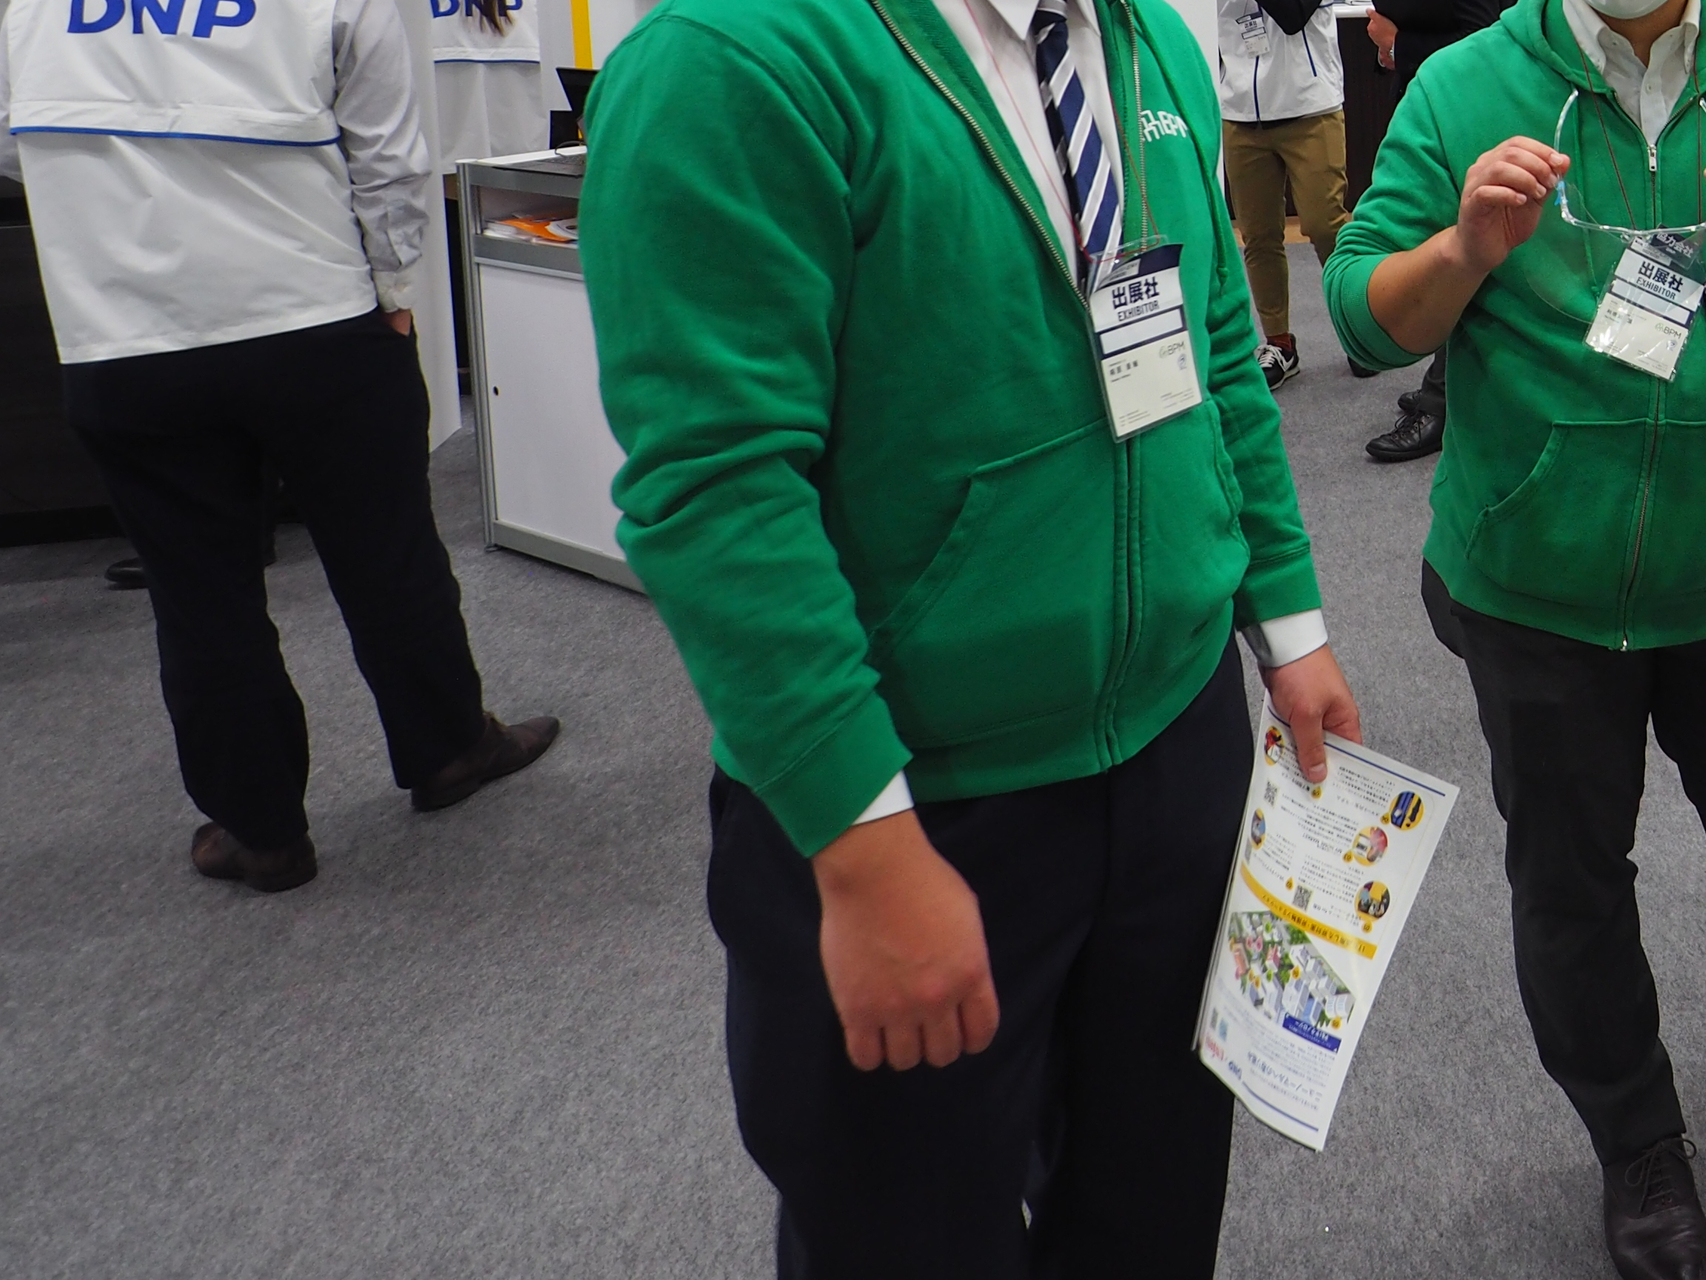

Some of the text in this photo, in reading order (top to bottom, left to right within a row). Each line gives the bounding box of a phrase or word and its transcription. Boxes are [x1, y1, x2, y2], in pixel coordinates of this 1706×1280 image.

[1635, 277, 1678, 301] EXHIBITOR
[1637, 260, 1685, 294] 出展社
[1111, 276, 1160, 310] 出展社
[1116, 299, 1160, 322] EXHIBITOR
